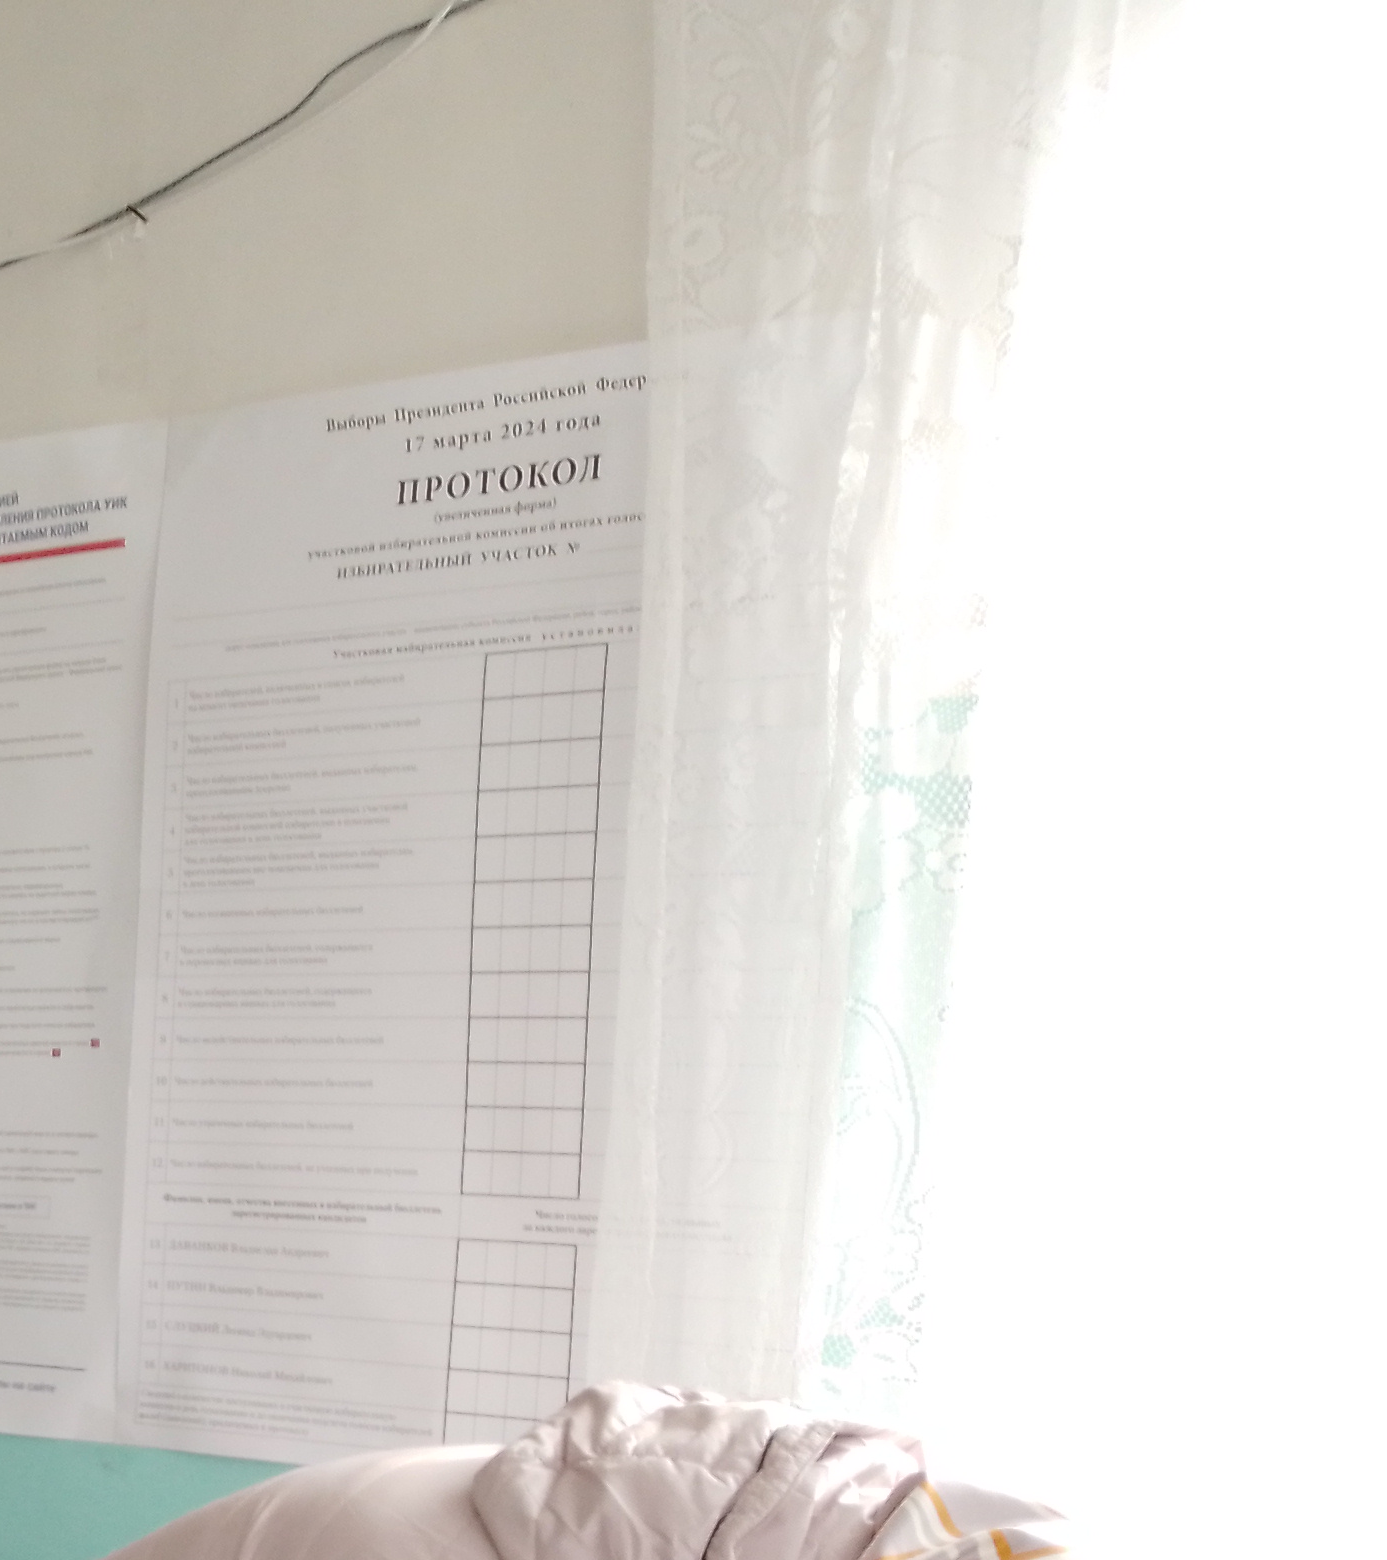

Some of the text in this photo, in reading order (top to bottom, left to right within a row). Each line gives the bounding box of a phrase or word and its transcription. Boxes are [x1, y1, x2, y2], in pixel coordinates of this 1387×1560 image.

[326, 373, 648, 434] Выборы Президента Российской Федер
[405, 413, 602, 453] 17 марта 2024 года
[396, 453, 603, 506] ПРОТОКОЛ
[105, 495, 128, 511] УИК
[480, 543, 559, 564] УЧАСТОК
